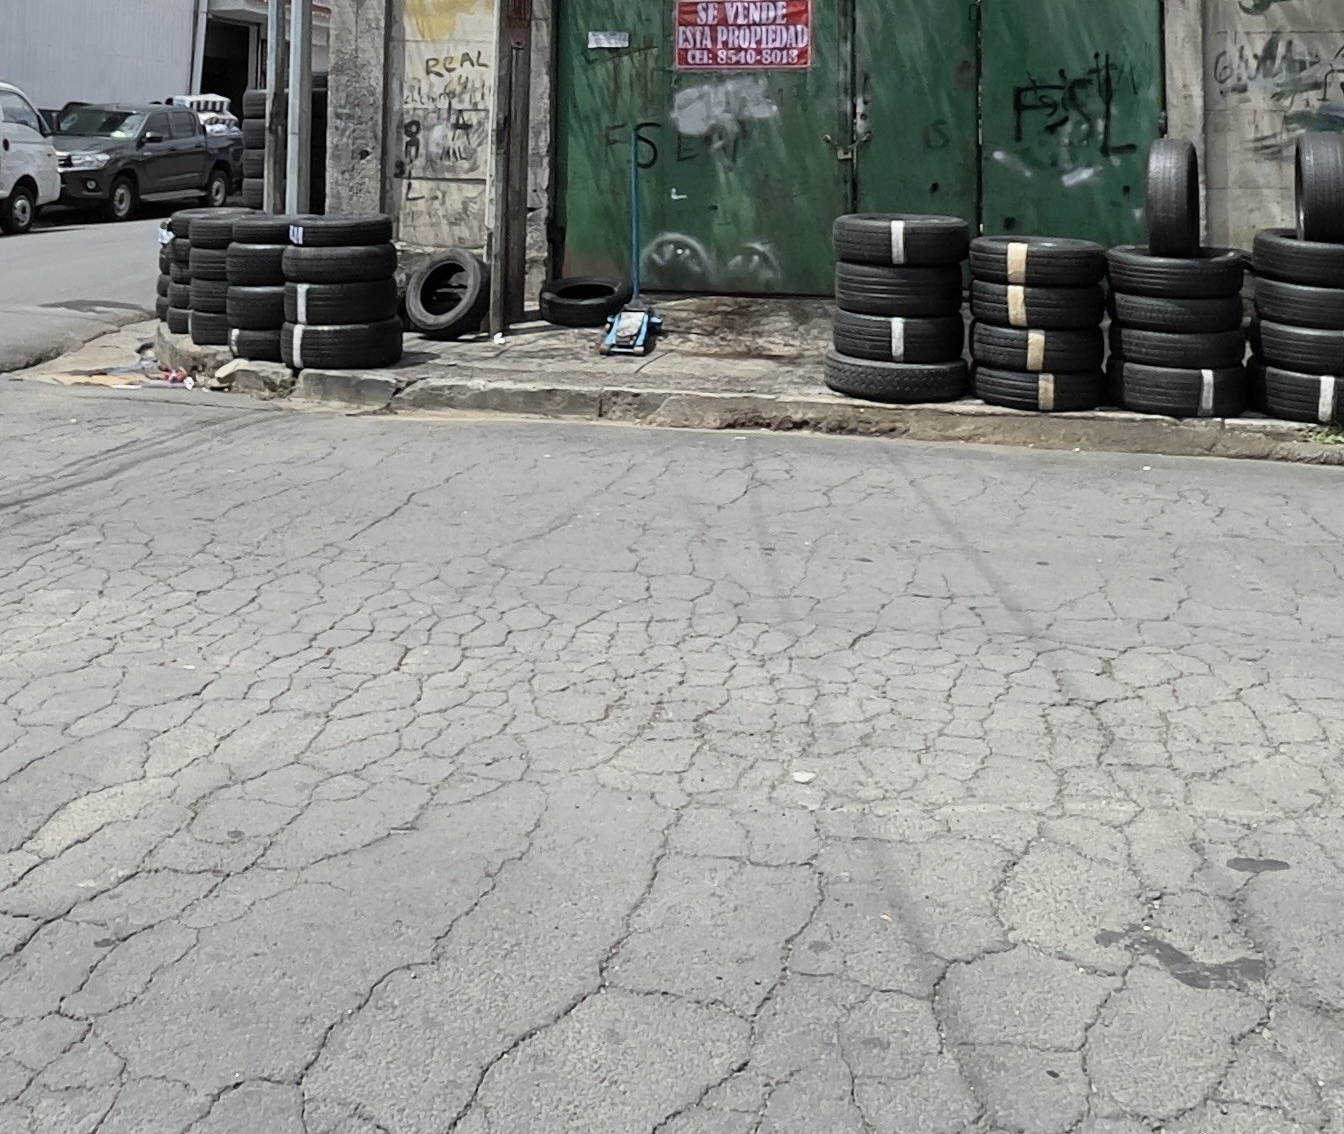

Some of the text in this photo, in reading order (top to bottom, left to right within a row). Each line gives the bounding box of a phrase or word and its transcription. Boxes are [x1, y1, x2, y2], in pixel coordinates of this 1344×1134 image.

[696, 1, 787, 25] SE VENDE
[678, 25, 808, 48] ESTA PROPIEDAD
[717, 49, 798, 64] 8540-8013
